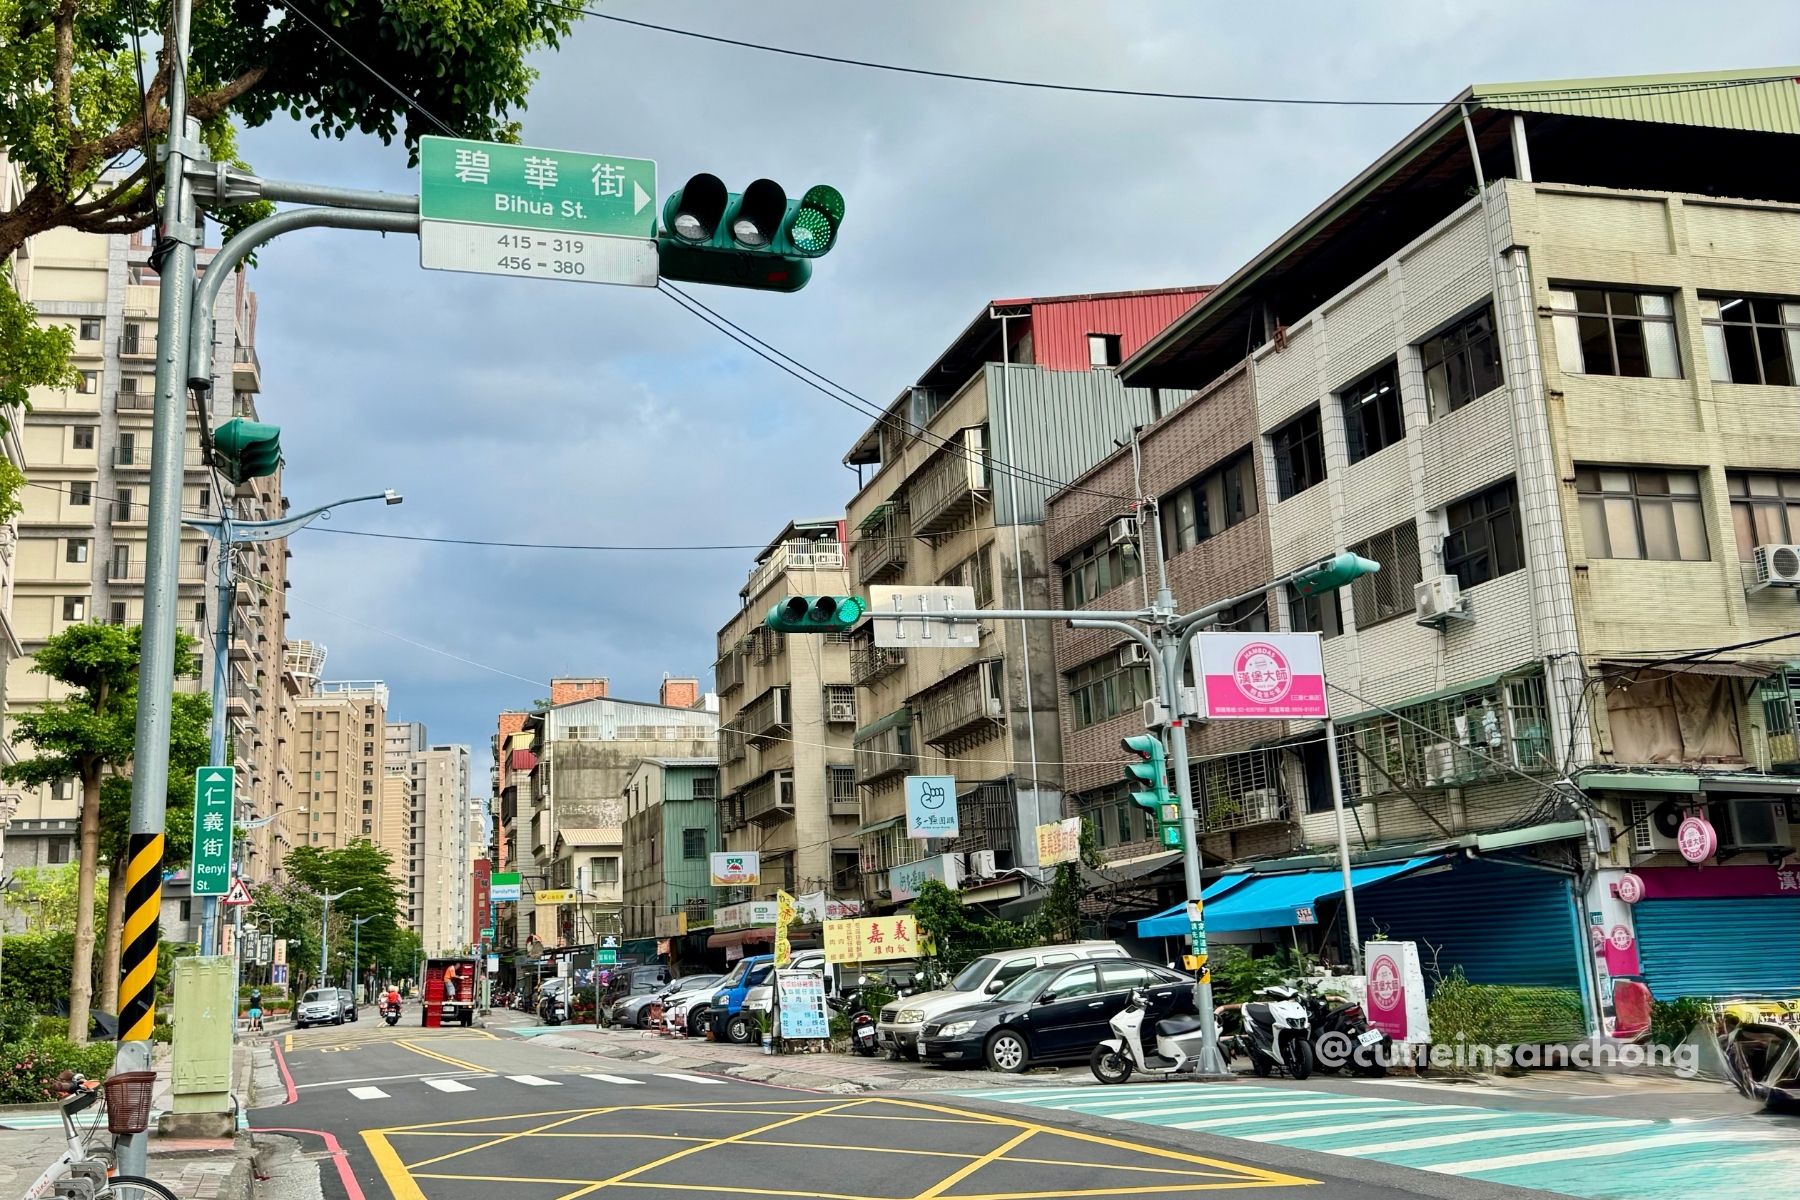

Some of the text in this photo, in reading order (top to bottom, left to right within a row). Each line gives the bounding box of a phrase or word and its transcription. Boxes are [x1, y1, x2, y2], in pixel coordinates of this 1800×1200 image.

[455, 149, 625, 198] 碧華街
[495, 193, 588, 219] Bihua St.
[1238, 669, 1289, 685] 漢堡大師
[202, 786, 226, 858] 仁義街
[197, 863, 226, 876] Renyi
[196, 880, 210, 891] St.
[867, 920, 910, 944] 嘉義
[874, 944, 907, 955] 雞肉飯
